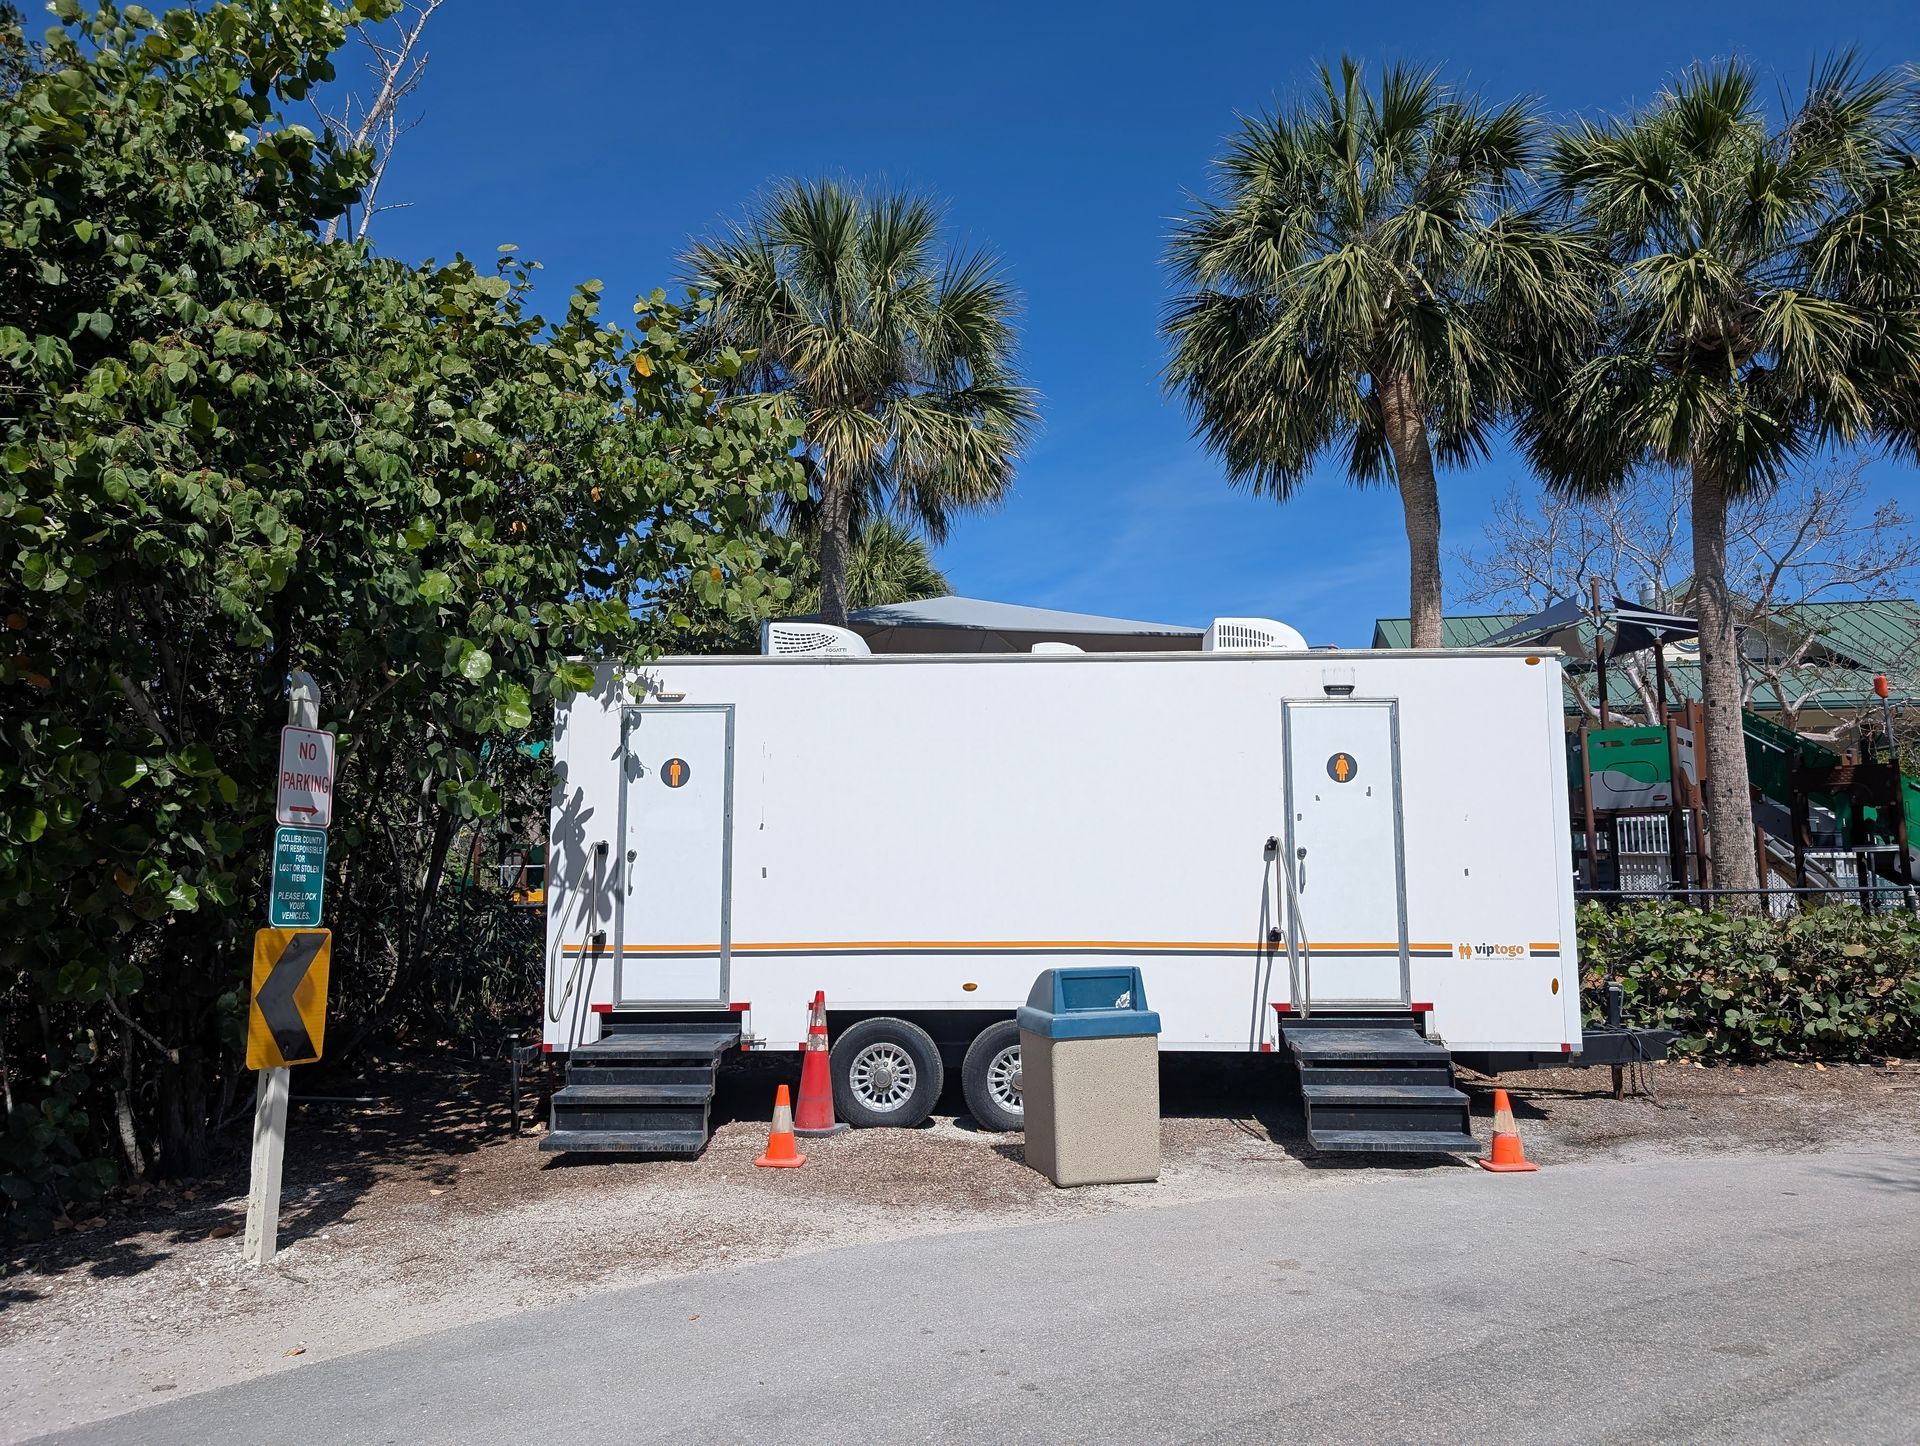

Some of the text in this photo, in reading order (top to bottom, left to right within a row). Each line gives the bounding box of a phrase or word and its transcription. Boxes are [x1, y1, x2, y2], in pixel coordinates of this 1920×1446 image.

[299, 742, 317, 761] NO
[283, 771, 329, 794] PARKING
[280, 834, 323, 845] COLLIER COUNTY
[278, 843, 323, 854] NOT RESPONSIBLE
[295, 854, 306, 863] FOR
[279, 863, 320, 873] LOST OR STOLEN
[291, 873, 307, 882] ITEMS
[277, 891, 318, 901] PLEASE LOCK
[289, 901, 305, 910] YOUR
[281, 911, 311, 920] VEHICLES.
[1474, 942, 1525, 957] viptogo
